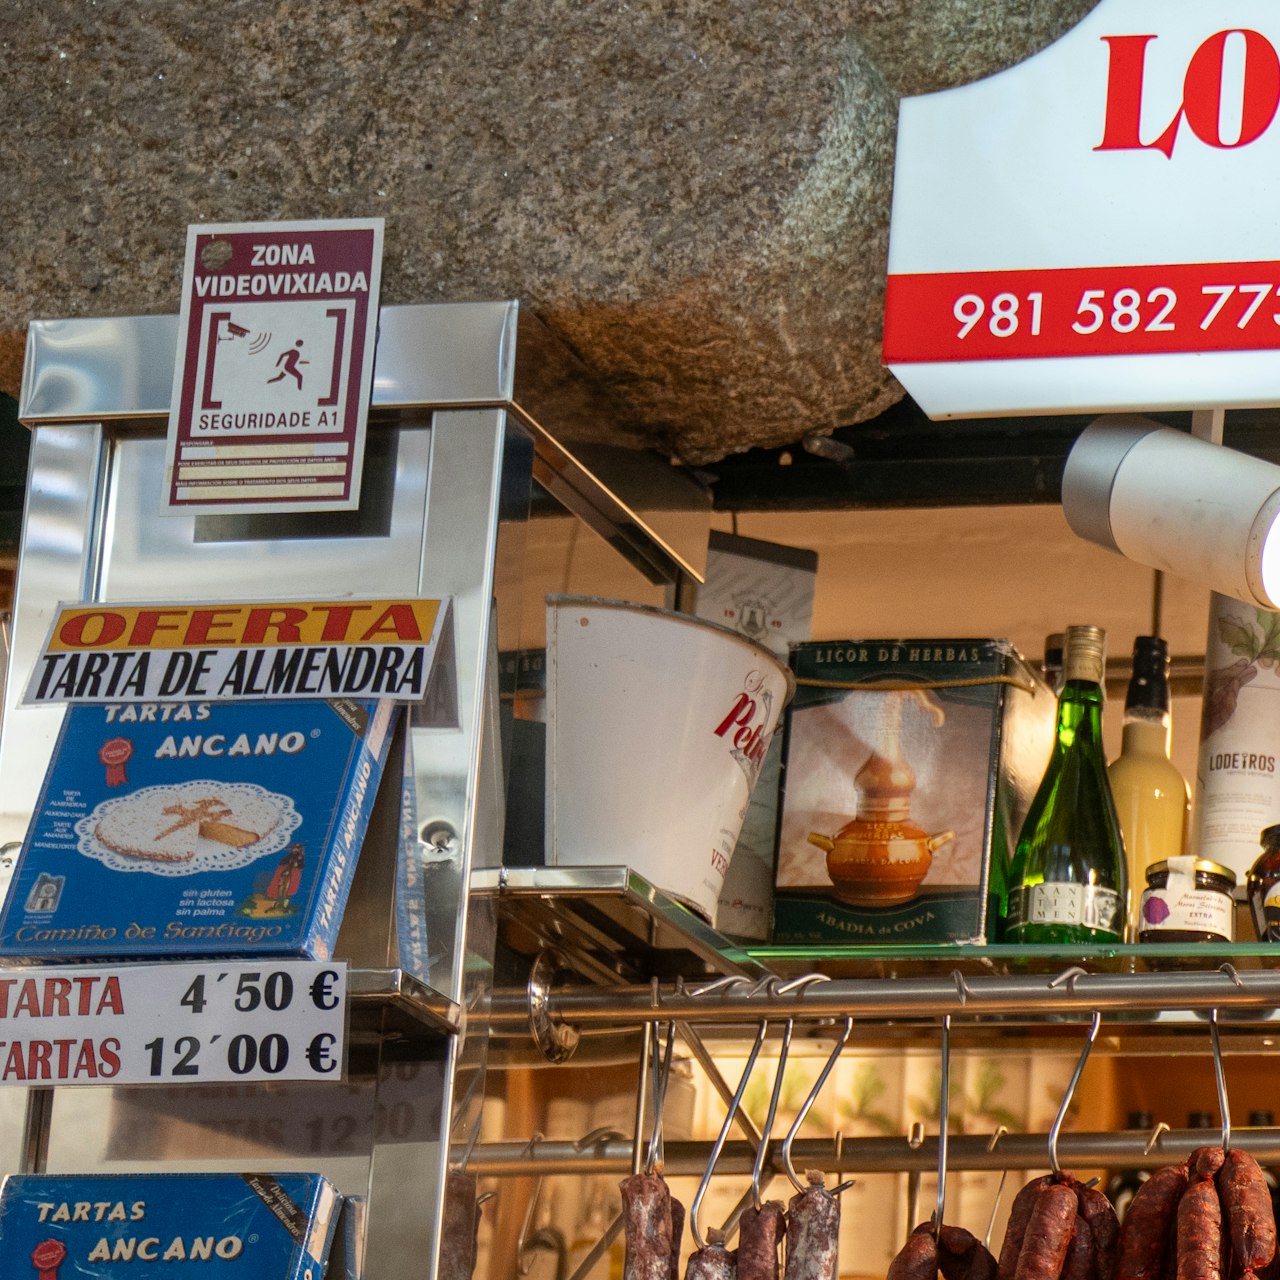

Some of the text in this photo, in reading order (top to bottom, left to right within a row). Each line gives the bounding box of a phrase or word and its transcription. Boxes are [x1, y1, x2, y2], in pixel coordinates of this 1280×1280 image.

[251, 244, 316, 266] ZONA
[195, 271, 368, 297] VIDEOVIXIADA
[953, 292, 1042, 339] 981
[1071, 287, 1177, 335] 582
[199, 411, 338, 430] SEGURIDADE A1
[59, 604, 424, 648] OFERTA
[816, 649, 979, 663] LICOR DE HERBAS
[35, 646, 425, 700] TARTA DE ALMENDRA
[104, 704, 212, 724] TARTAS
[155, 731, 308, 760] ANCANO
[320, 761, 371, 929] TARTAS ANCANO
[196, 898, 235, 906] lactosa
[200, 889, 233, 898] gluten
[192, 908, 225, 917] palma
[0, 976, 125, 1018] TARTA
[309, 970, 340, 1010] €
[305, 1032, 337, 1073] €
[37, 1201, 146, 1222] TARTAS
[88, 1236, 245, 1262] ANCANO
